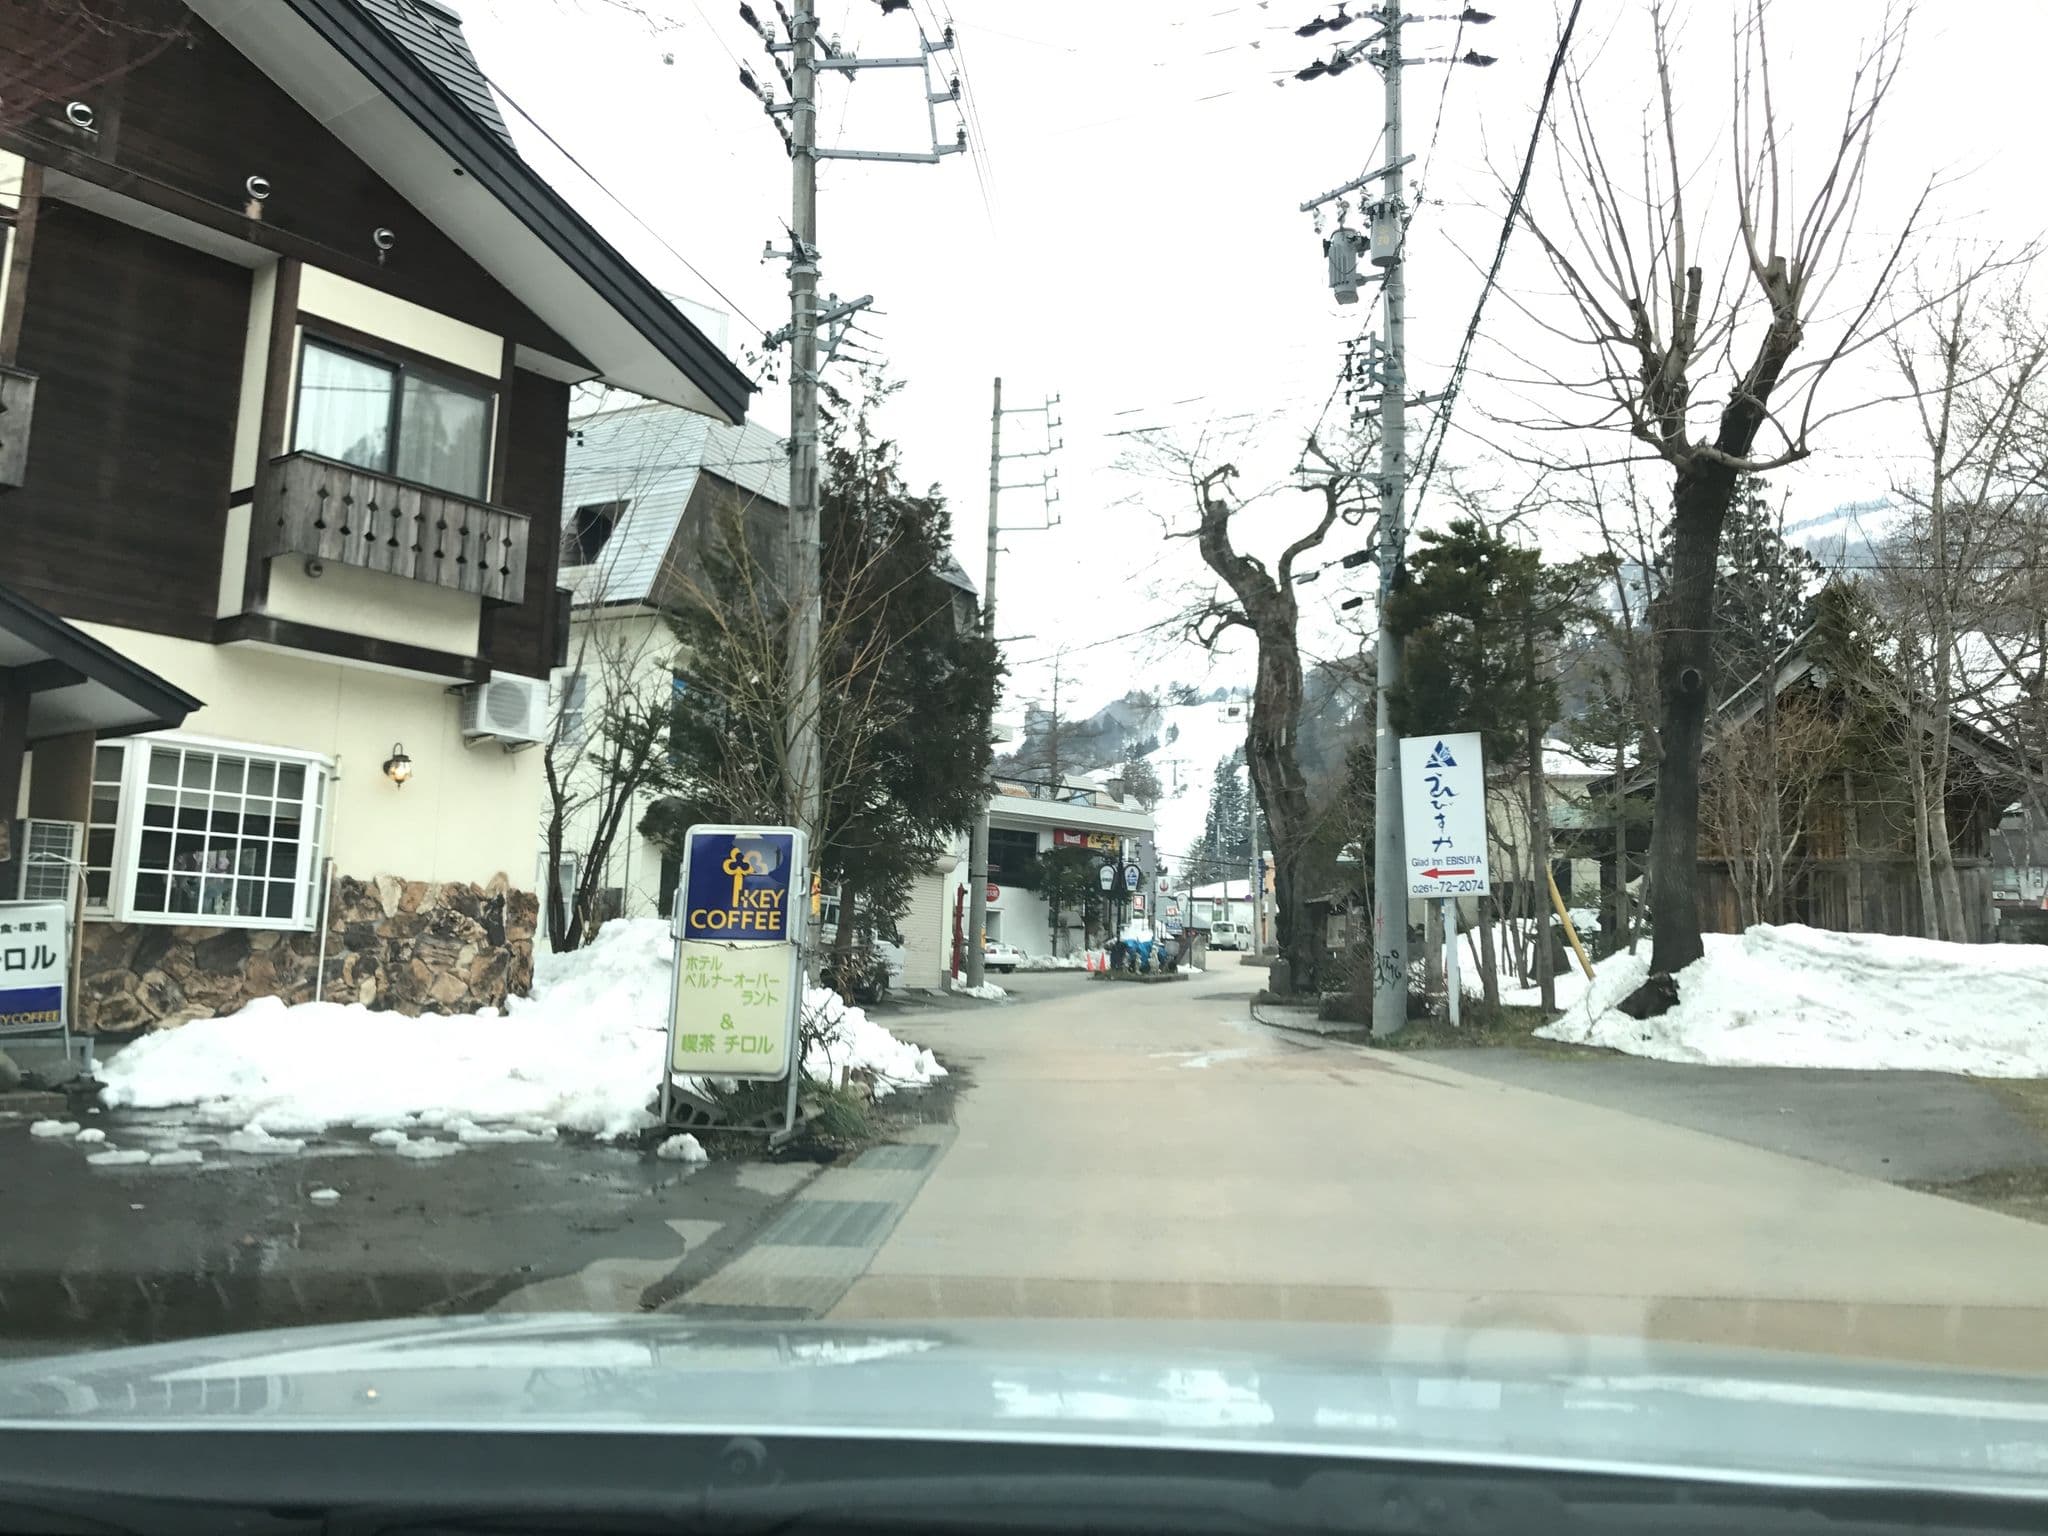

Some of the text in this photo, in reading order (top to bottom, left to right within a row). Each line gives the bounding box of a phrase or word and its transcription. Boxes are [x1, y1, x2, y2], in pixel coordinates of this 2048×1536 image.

[1432, 857, 1443, 866] Inn
[1445, 855, 1482, 866] EBISUYA
[1412, 880, 1484, 893] 0261-72-2074
[745, 889, 784, 909] KEY
[690, 909, 781, 930] COFFEE
[0, 945, 57, 971] ロル
[686, 955, 723, 971] ホテル
[742, 990, 779, 1006] ラント
[720, 1013, 735, 1030] &
[681, 1033, 774, 1055] 喫茶 チロル
